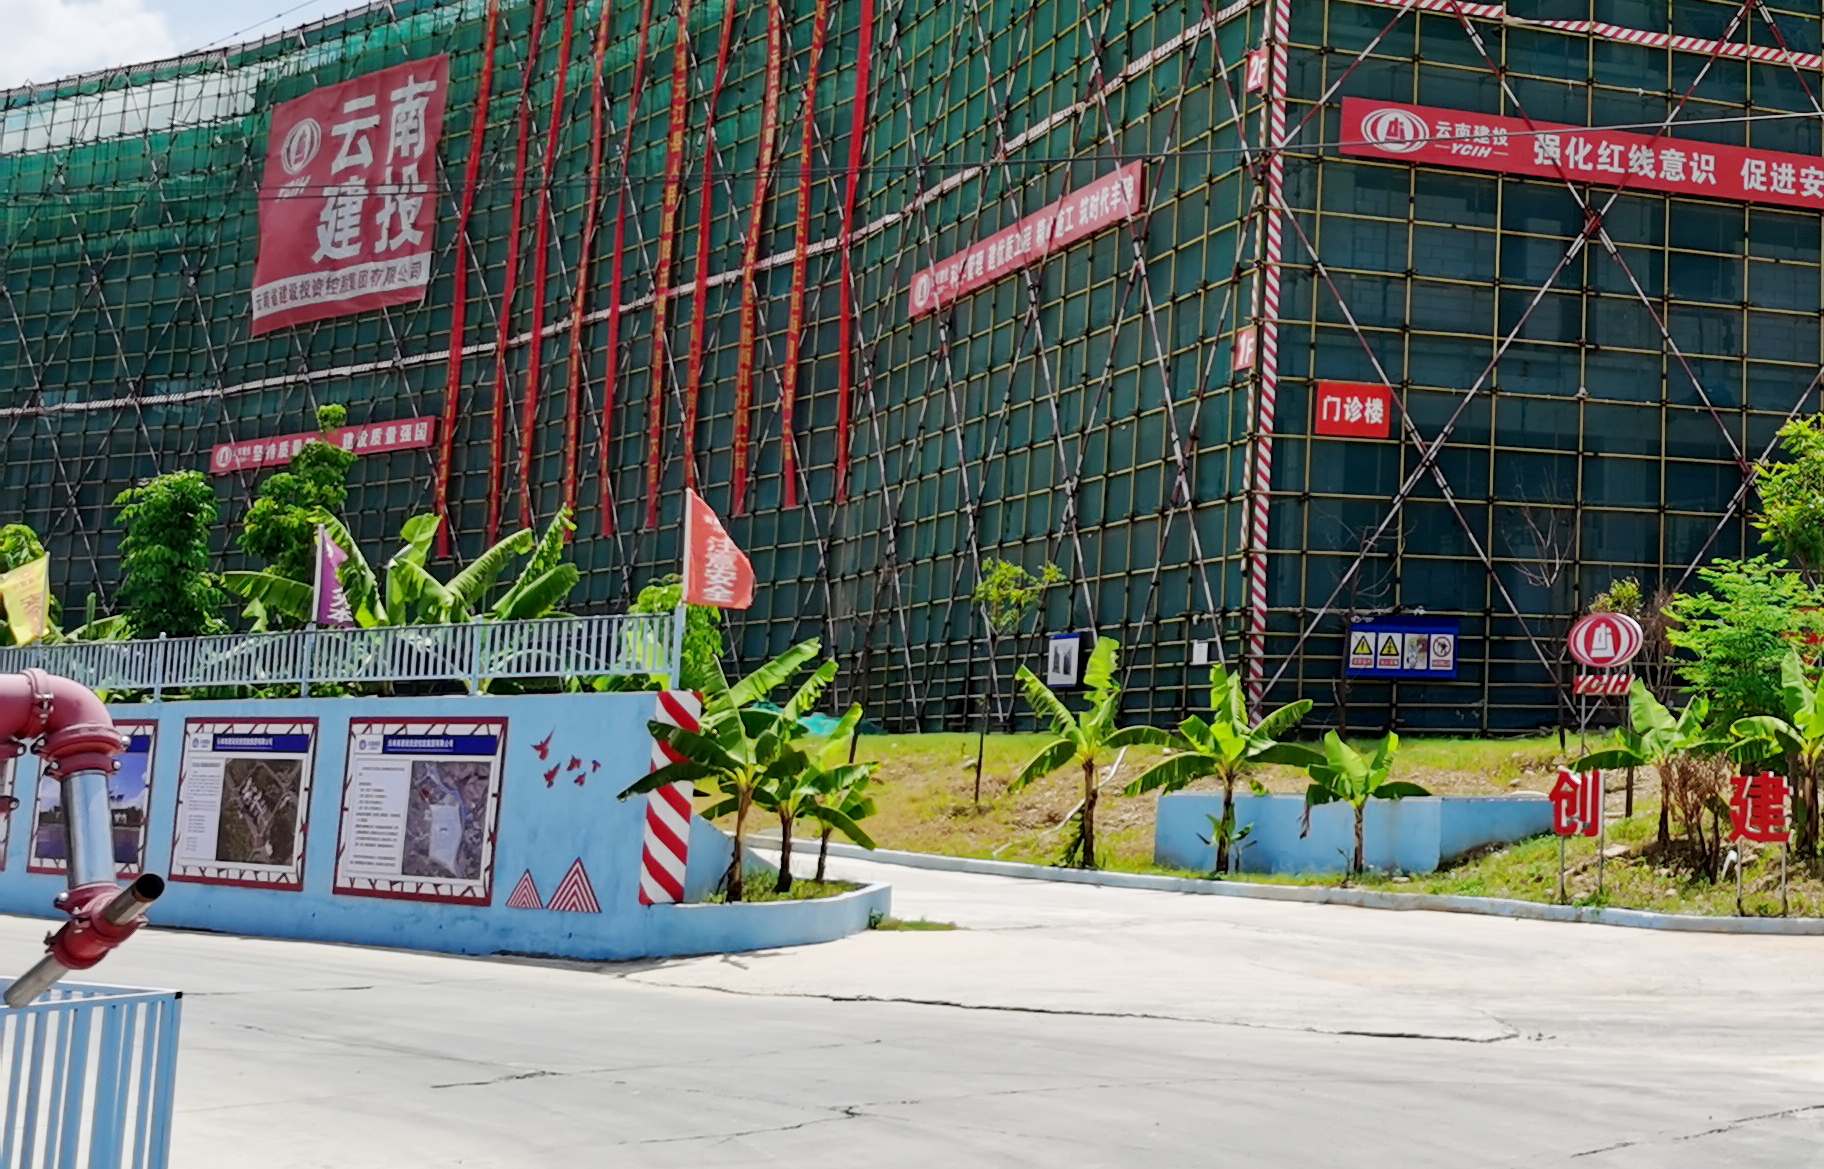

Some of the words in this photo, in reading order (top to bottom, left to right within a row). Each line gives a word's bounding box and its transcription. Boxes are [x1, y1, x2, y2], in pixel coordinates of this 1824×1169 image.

[1248, 55, 1268, 89] 2F
[331, 74, 437, 175] 云南
[1435, 120, 1510, 148] 云南建投
[1451, 142, 1492, 159] YCIH
[1533, 133, 1718, 186] 强化红线意识
[311, 163, 429, 263] 建投
[1239, 333, 1255, 365] 1F
[1322, 395, 1384, 424] 门诊楼
[1573, 674, 1636, 695] YCIH
